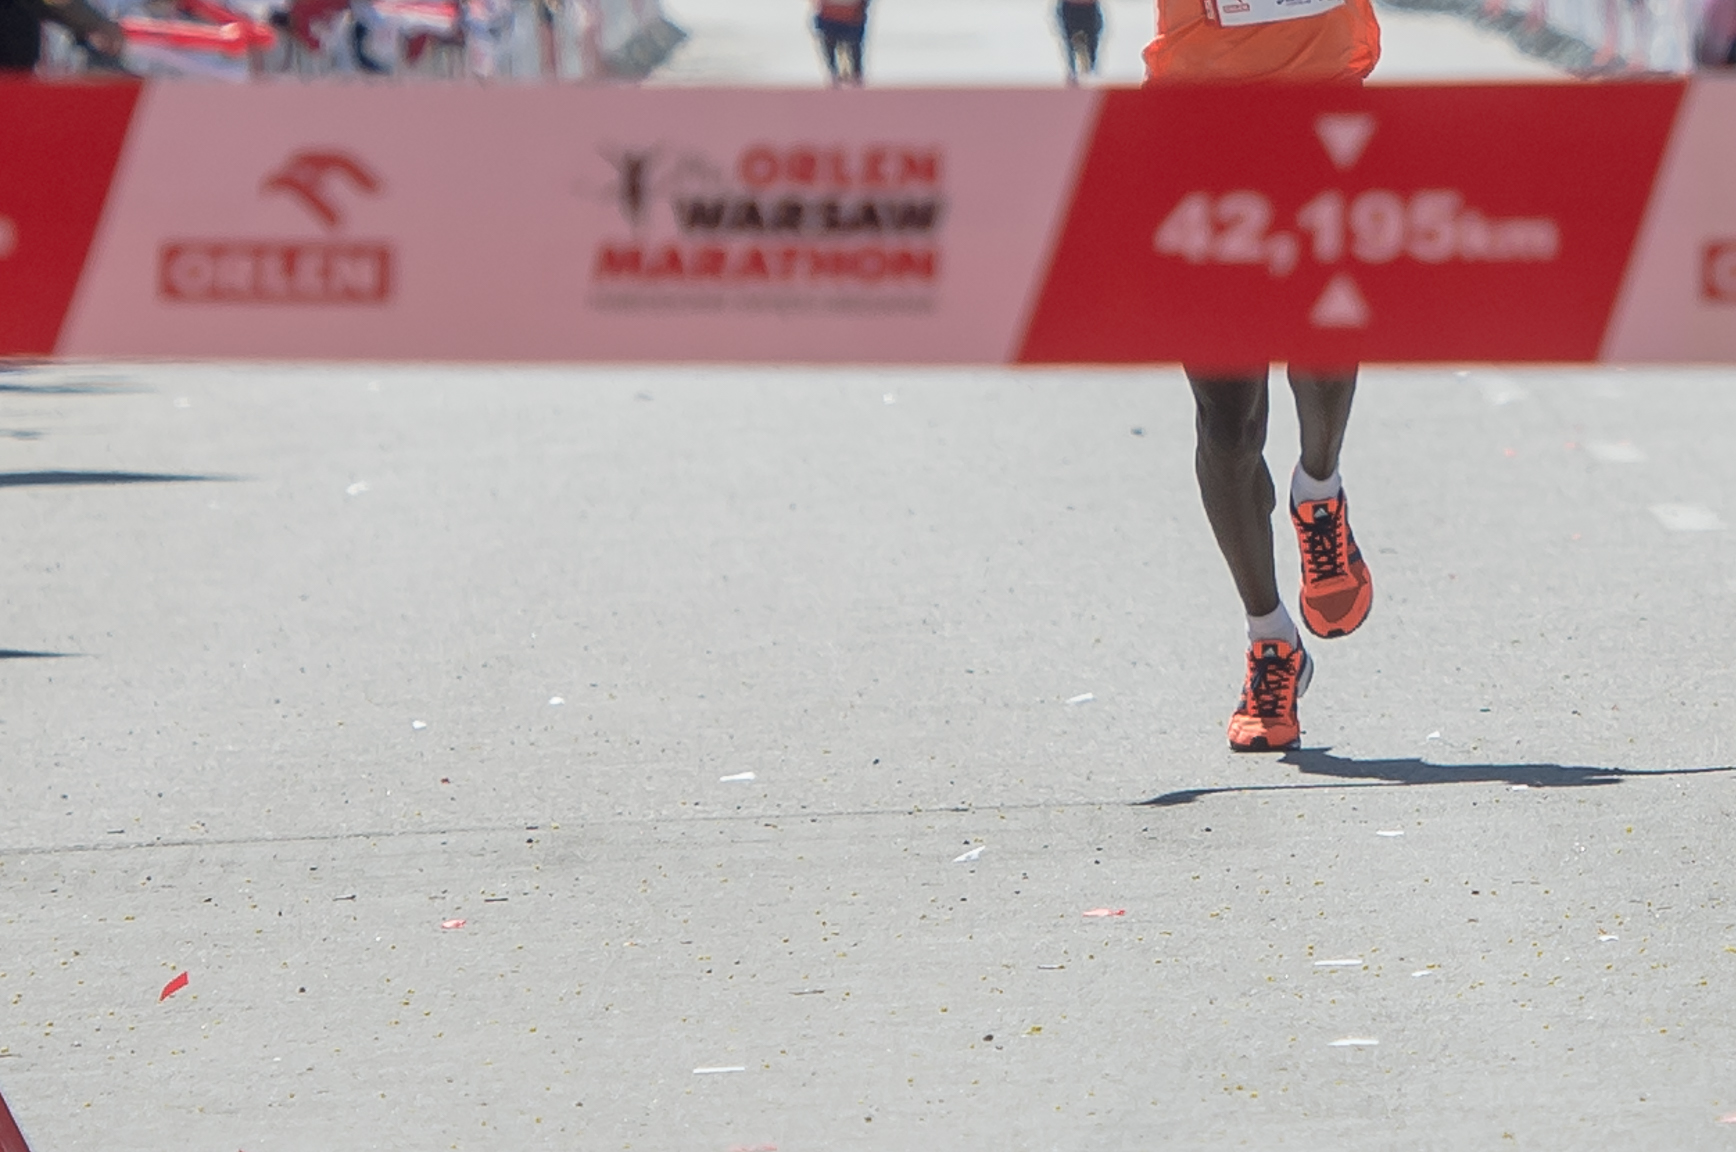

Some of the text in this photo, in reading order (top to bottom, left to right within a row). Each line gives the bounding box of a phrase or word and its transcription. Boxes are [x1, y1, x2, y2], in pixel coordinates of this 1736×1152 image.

[738, 145, 940, 189] ORLEN
[672, 194, 943, 235] WARSAW
[166, 249, 382, 295] ORLEN
[590, 241, 940, 283] MARATHON
